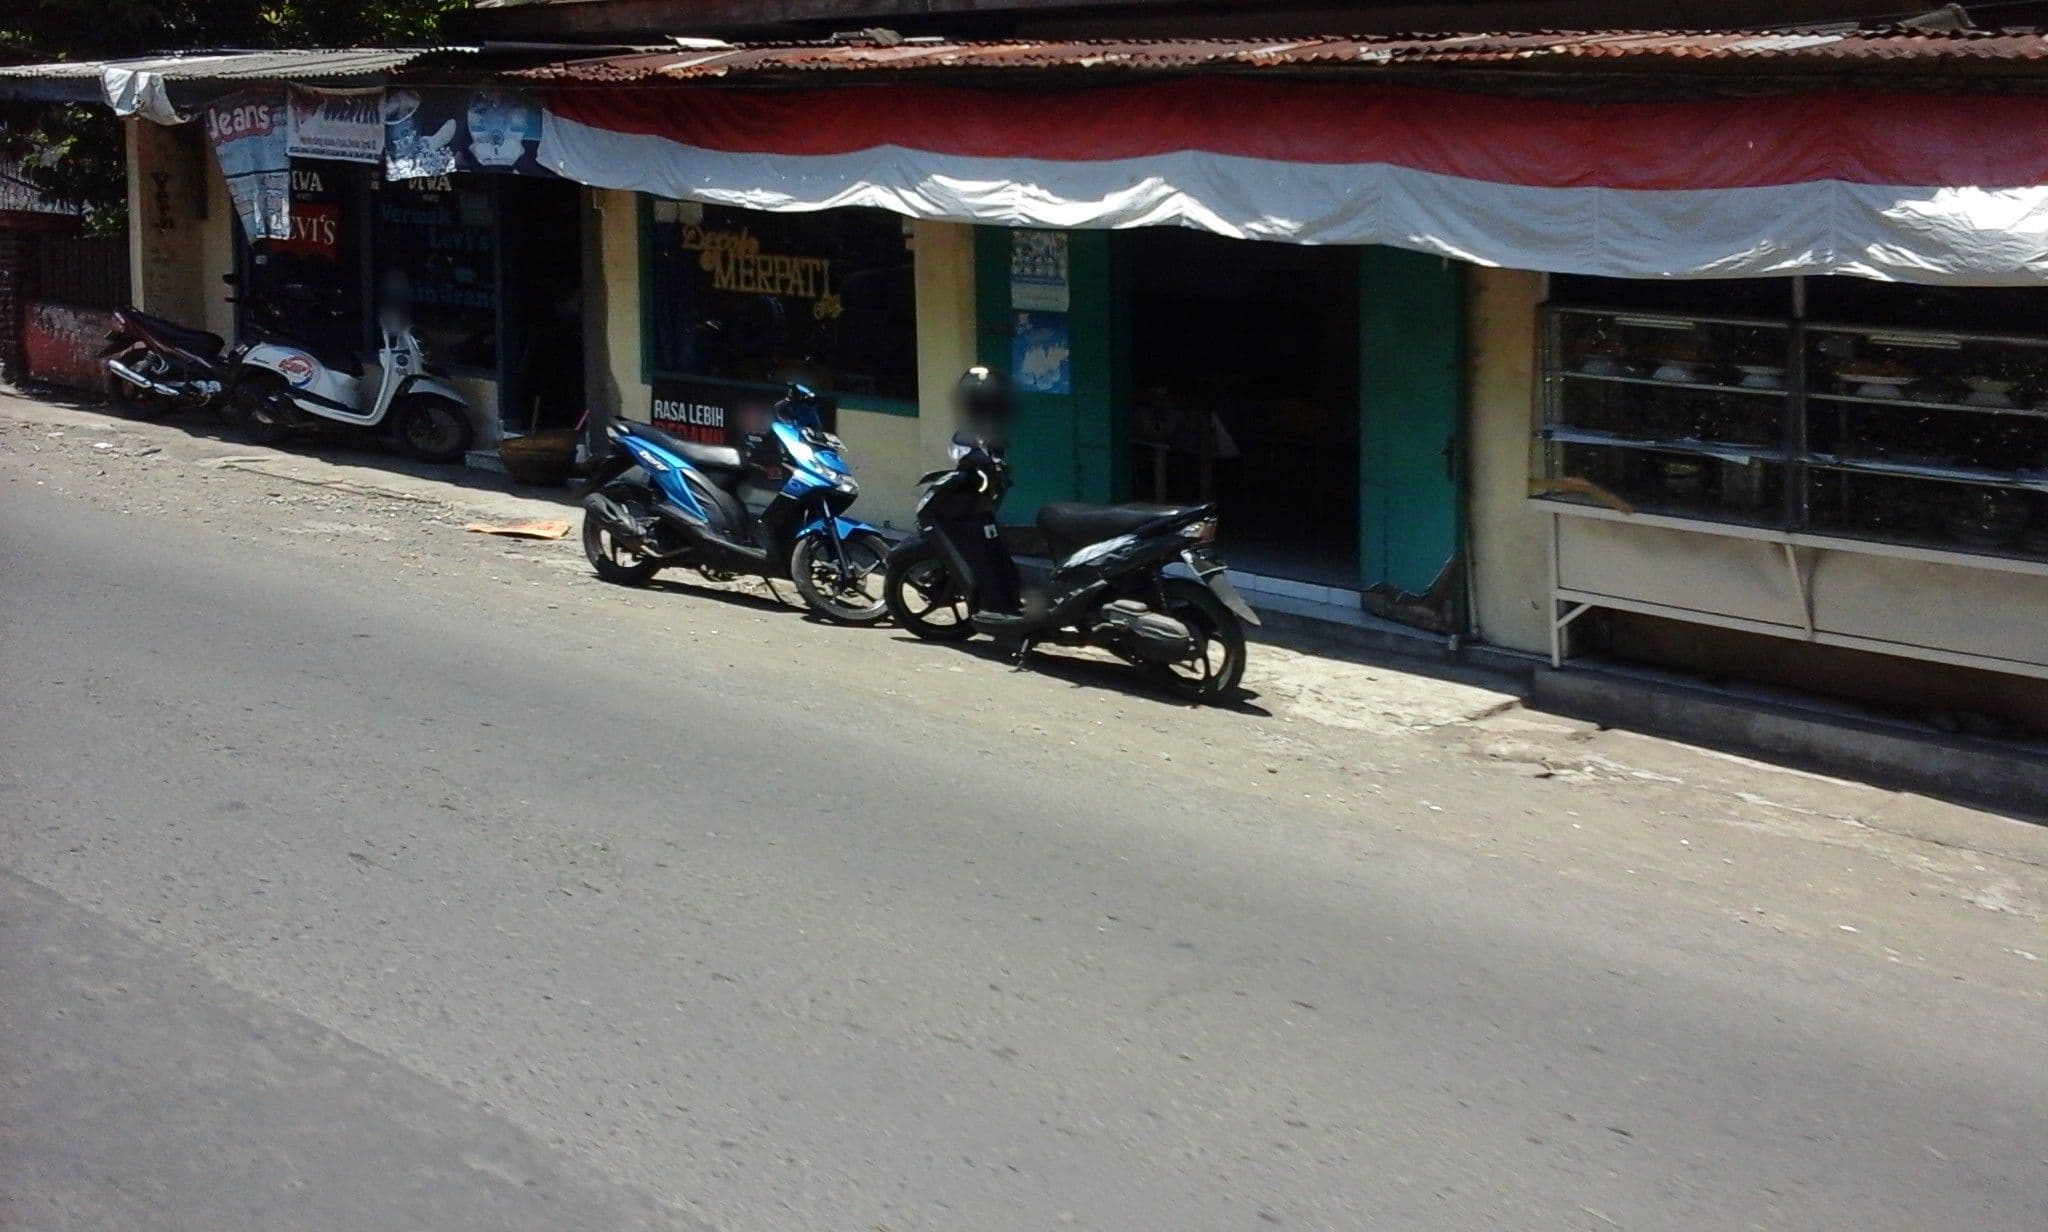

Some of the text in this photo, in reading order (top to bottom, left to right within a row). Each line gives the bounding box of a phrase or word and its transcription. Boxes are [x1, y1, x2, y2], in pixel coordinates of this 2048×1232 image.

[208, 104, 270, 140] Jeans
[291, 214, 336, 246] VI'S
[711, 253, 831, 297] MERPATI
[654, 399, 724, 427] RASA LEBIH
